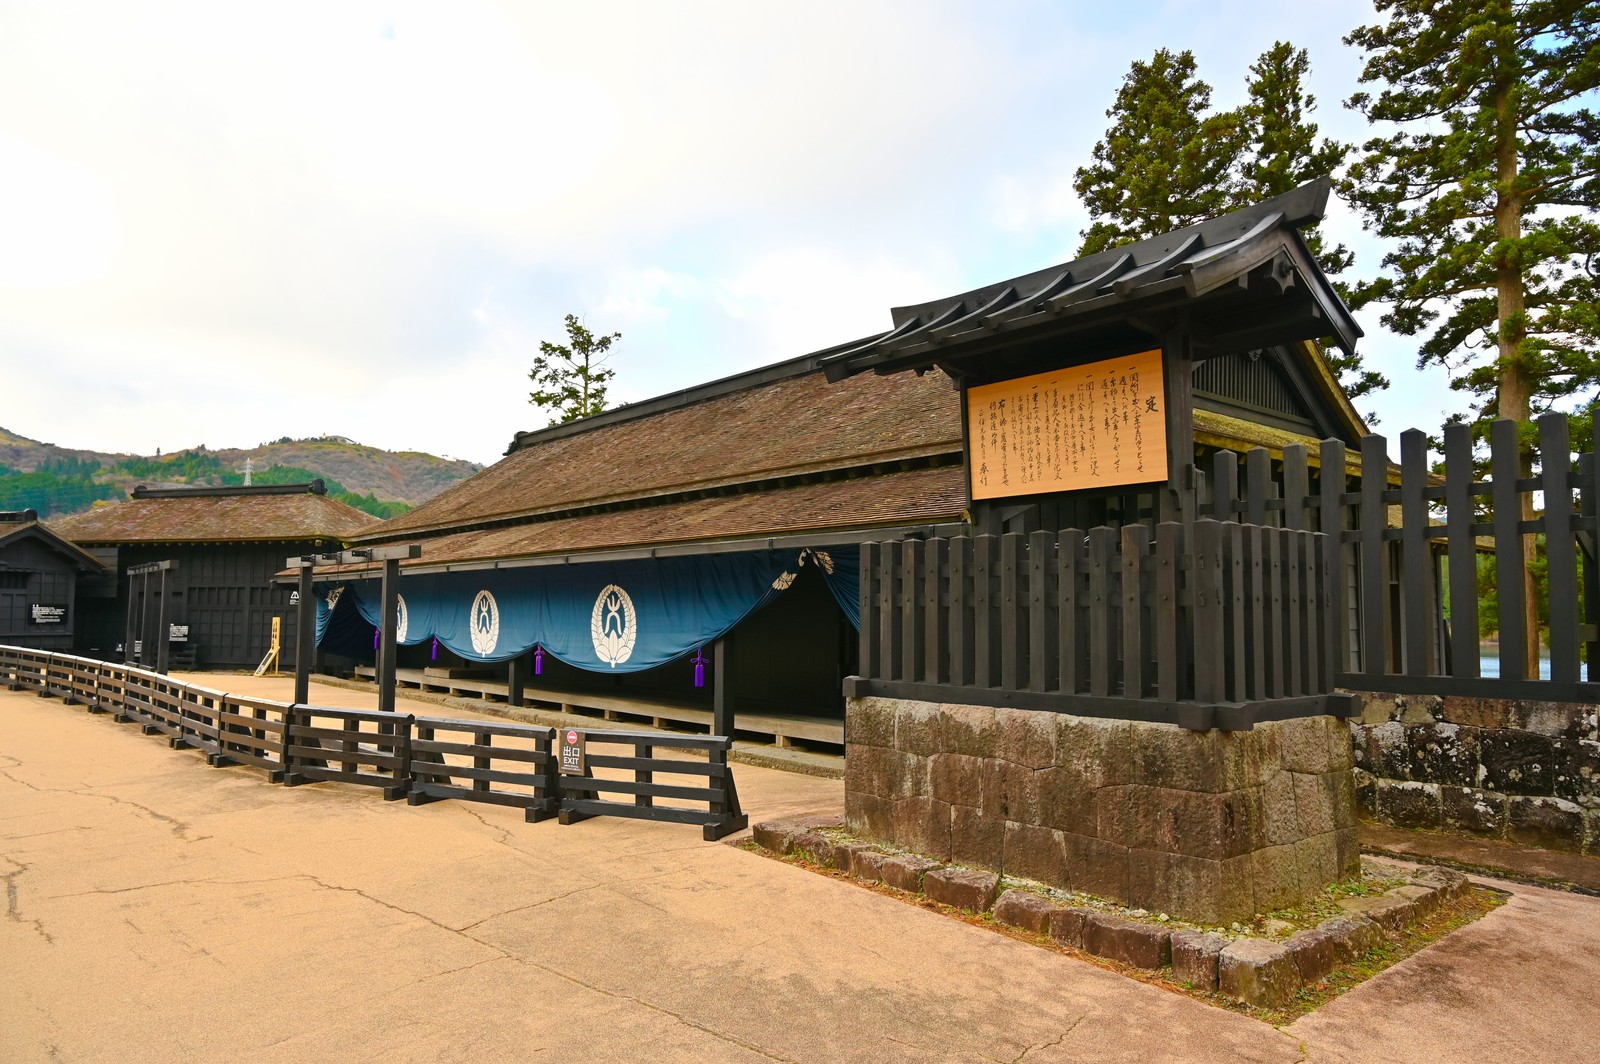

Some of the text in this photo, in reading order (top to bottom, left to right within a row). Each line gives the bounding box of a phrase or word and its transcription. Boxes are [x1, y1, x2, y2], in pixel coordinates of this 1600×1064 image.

[1144, 395, 1159, 413] 定
[563, 746, 580, 757] 出口
[563, 756, 579, 765] EXIT
